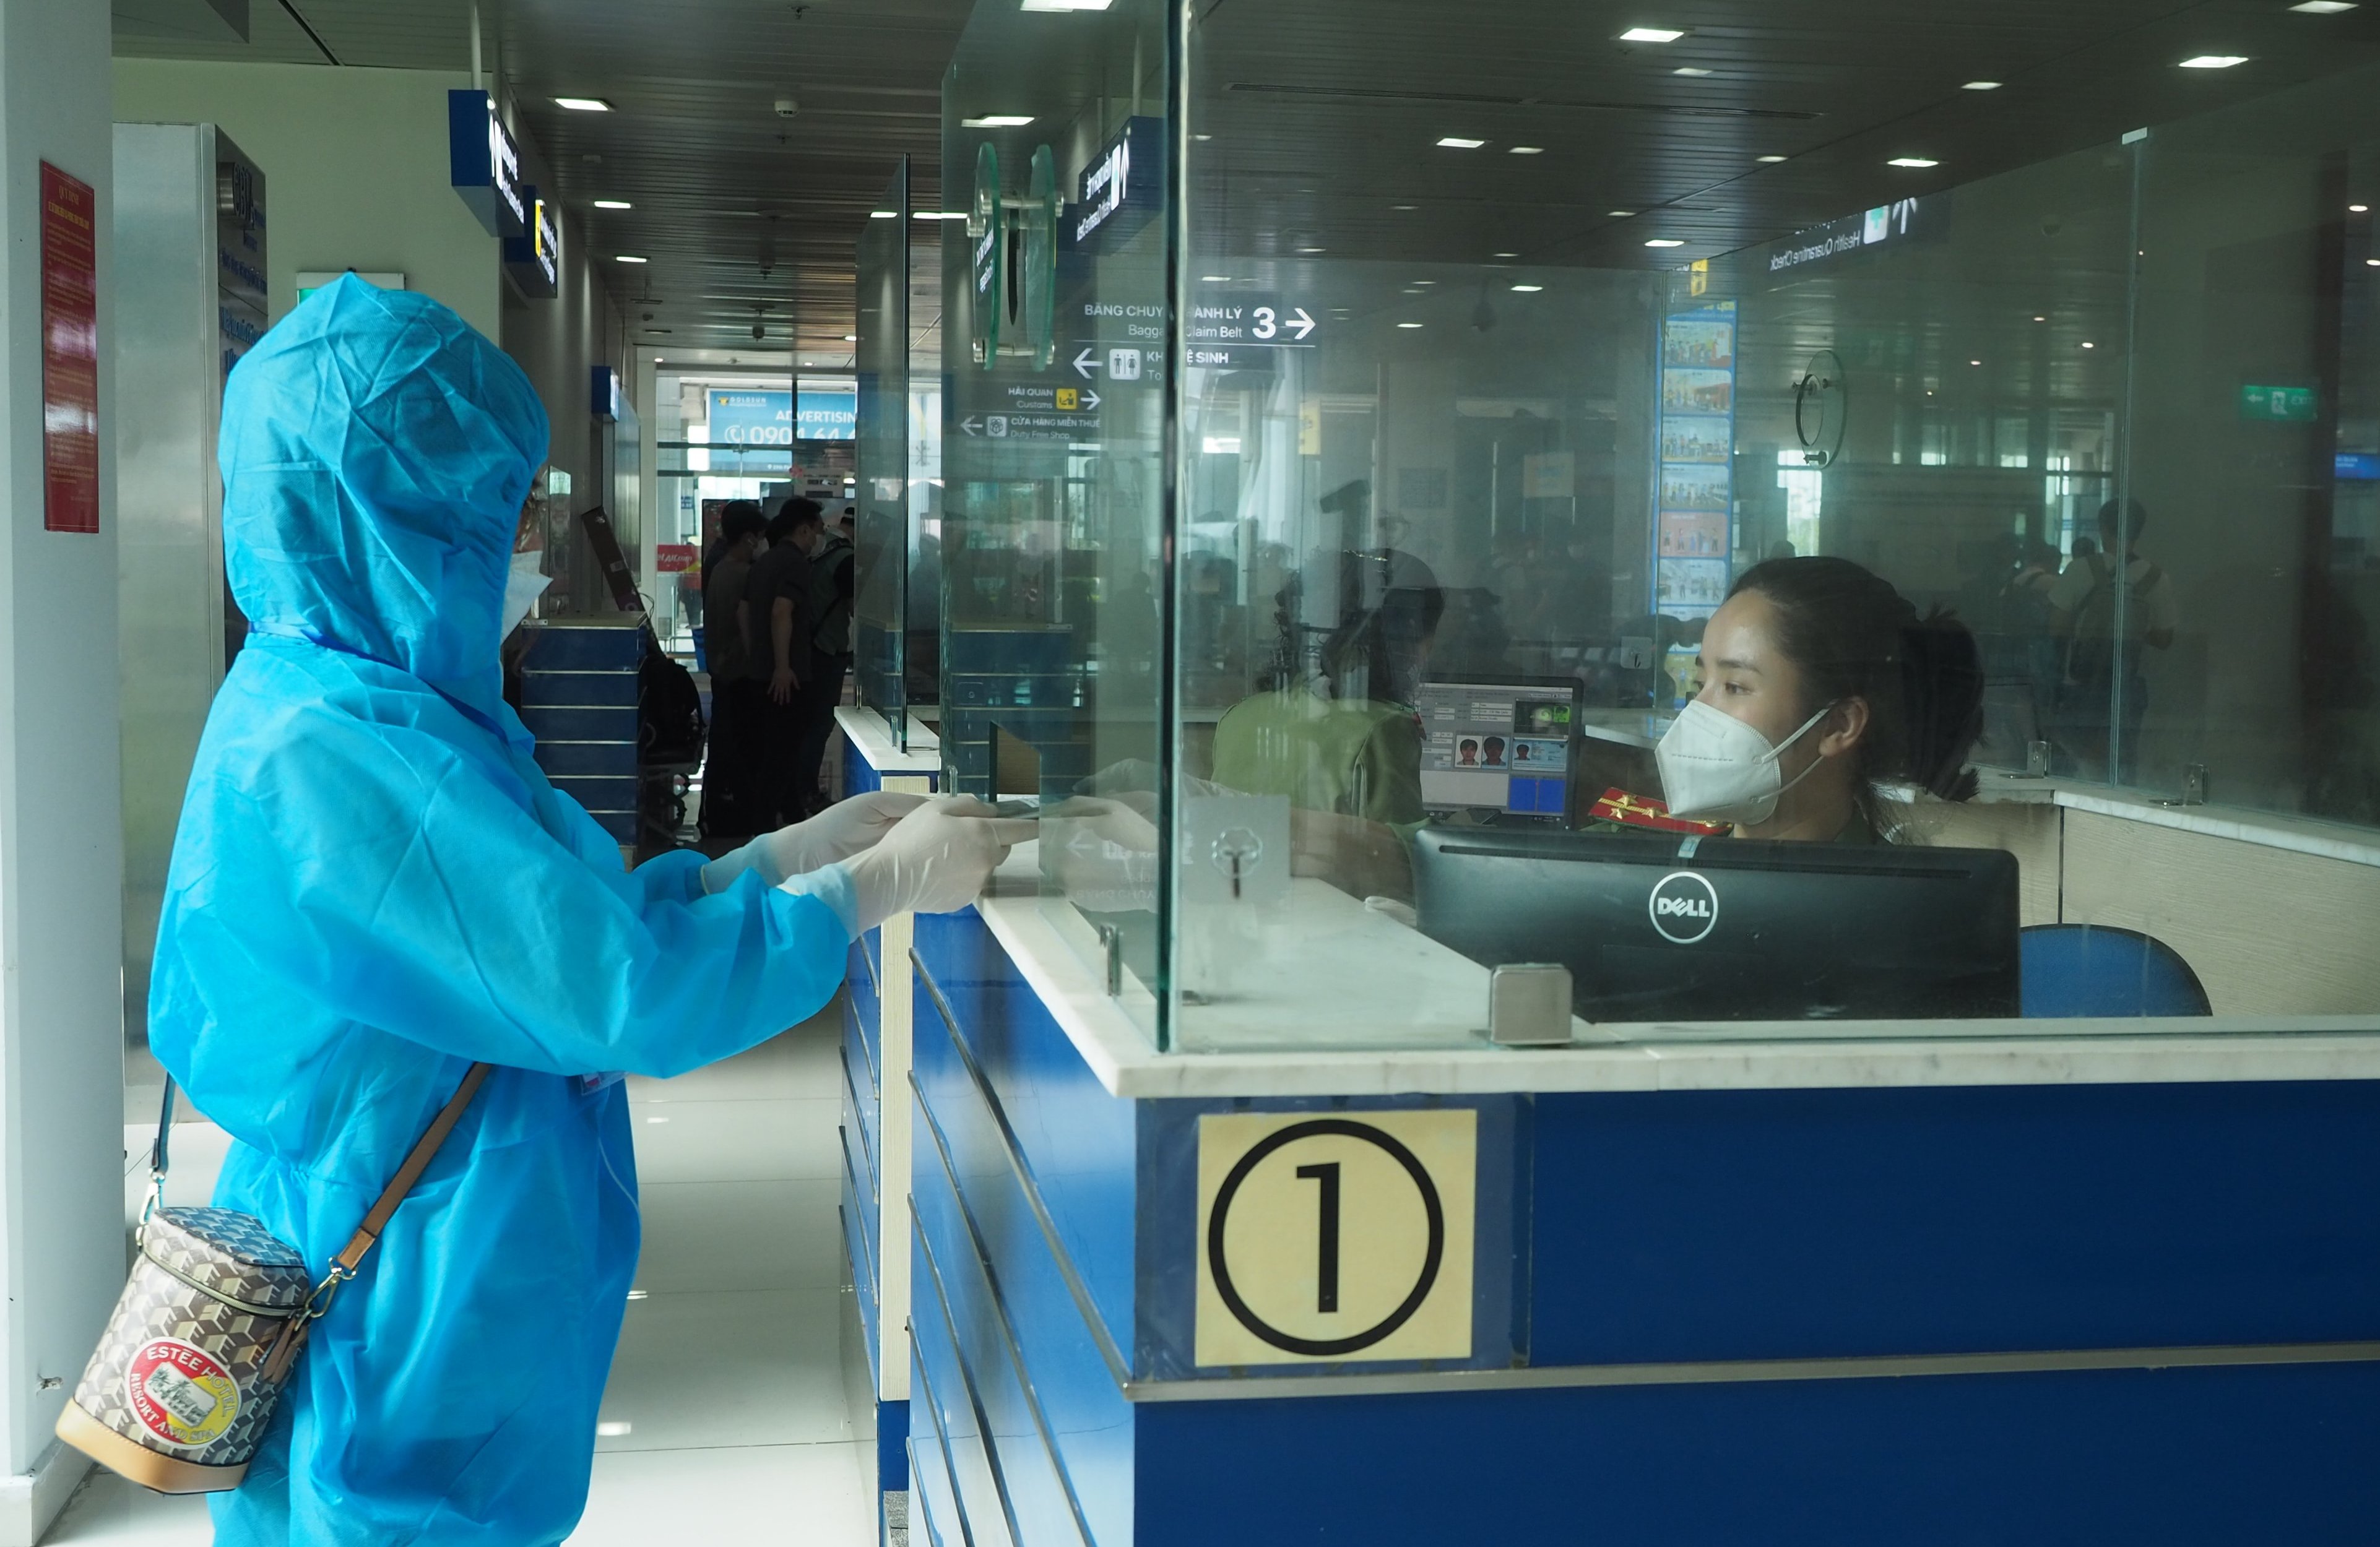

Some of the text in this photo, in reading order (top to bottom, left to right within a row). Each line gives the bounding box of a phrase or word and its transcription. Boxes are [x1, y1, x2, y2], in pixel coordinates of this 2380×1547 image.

[1084, 302, 1243, 319] BĂNG CHUY ÀNH LÝ
[1128, 324, 1164, 338] Bagga
[1220, 326, 1243, 338] Belt
[1252, 306, 1277, 339] 3
[1146, 348, 1229, 366] KH Ệ SINH
[1027, 388, 1054, 397] QUAN
[1016, 400, 1053, 409] Customs
[775, 410, 857, 423] ADVERTISIN
[1050, 431, 1070, 439] Shop
[1657, 897, 1710, 918] DELL
[1296, 1161, 1340, 1313] 1
[201, 1366, 235, 1417] HOTEL
[131, 1372, 215, 1441] RESORT AND SPA
